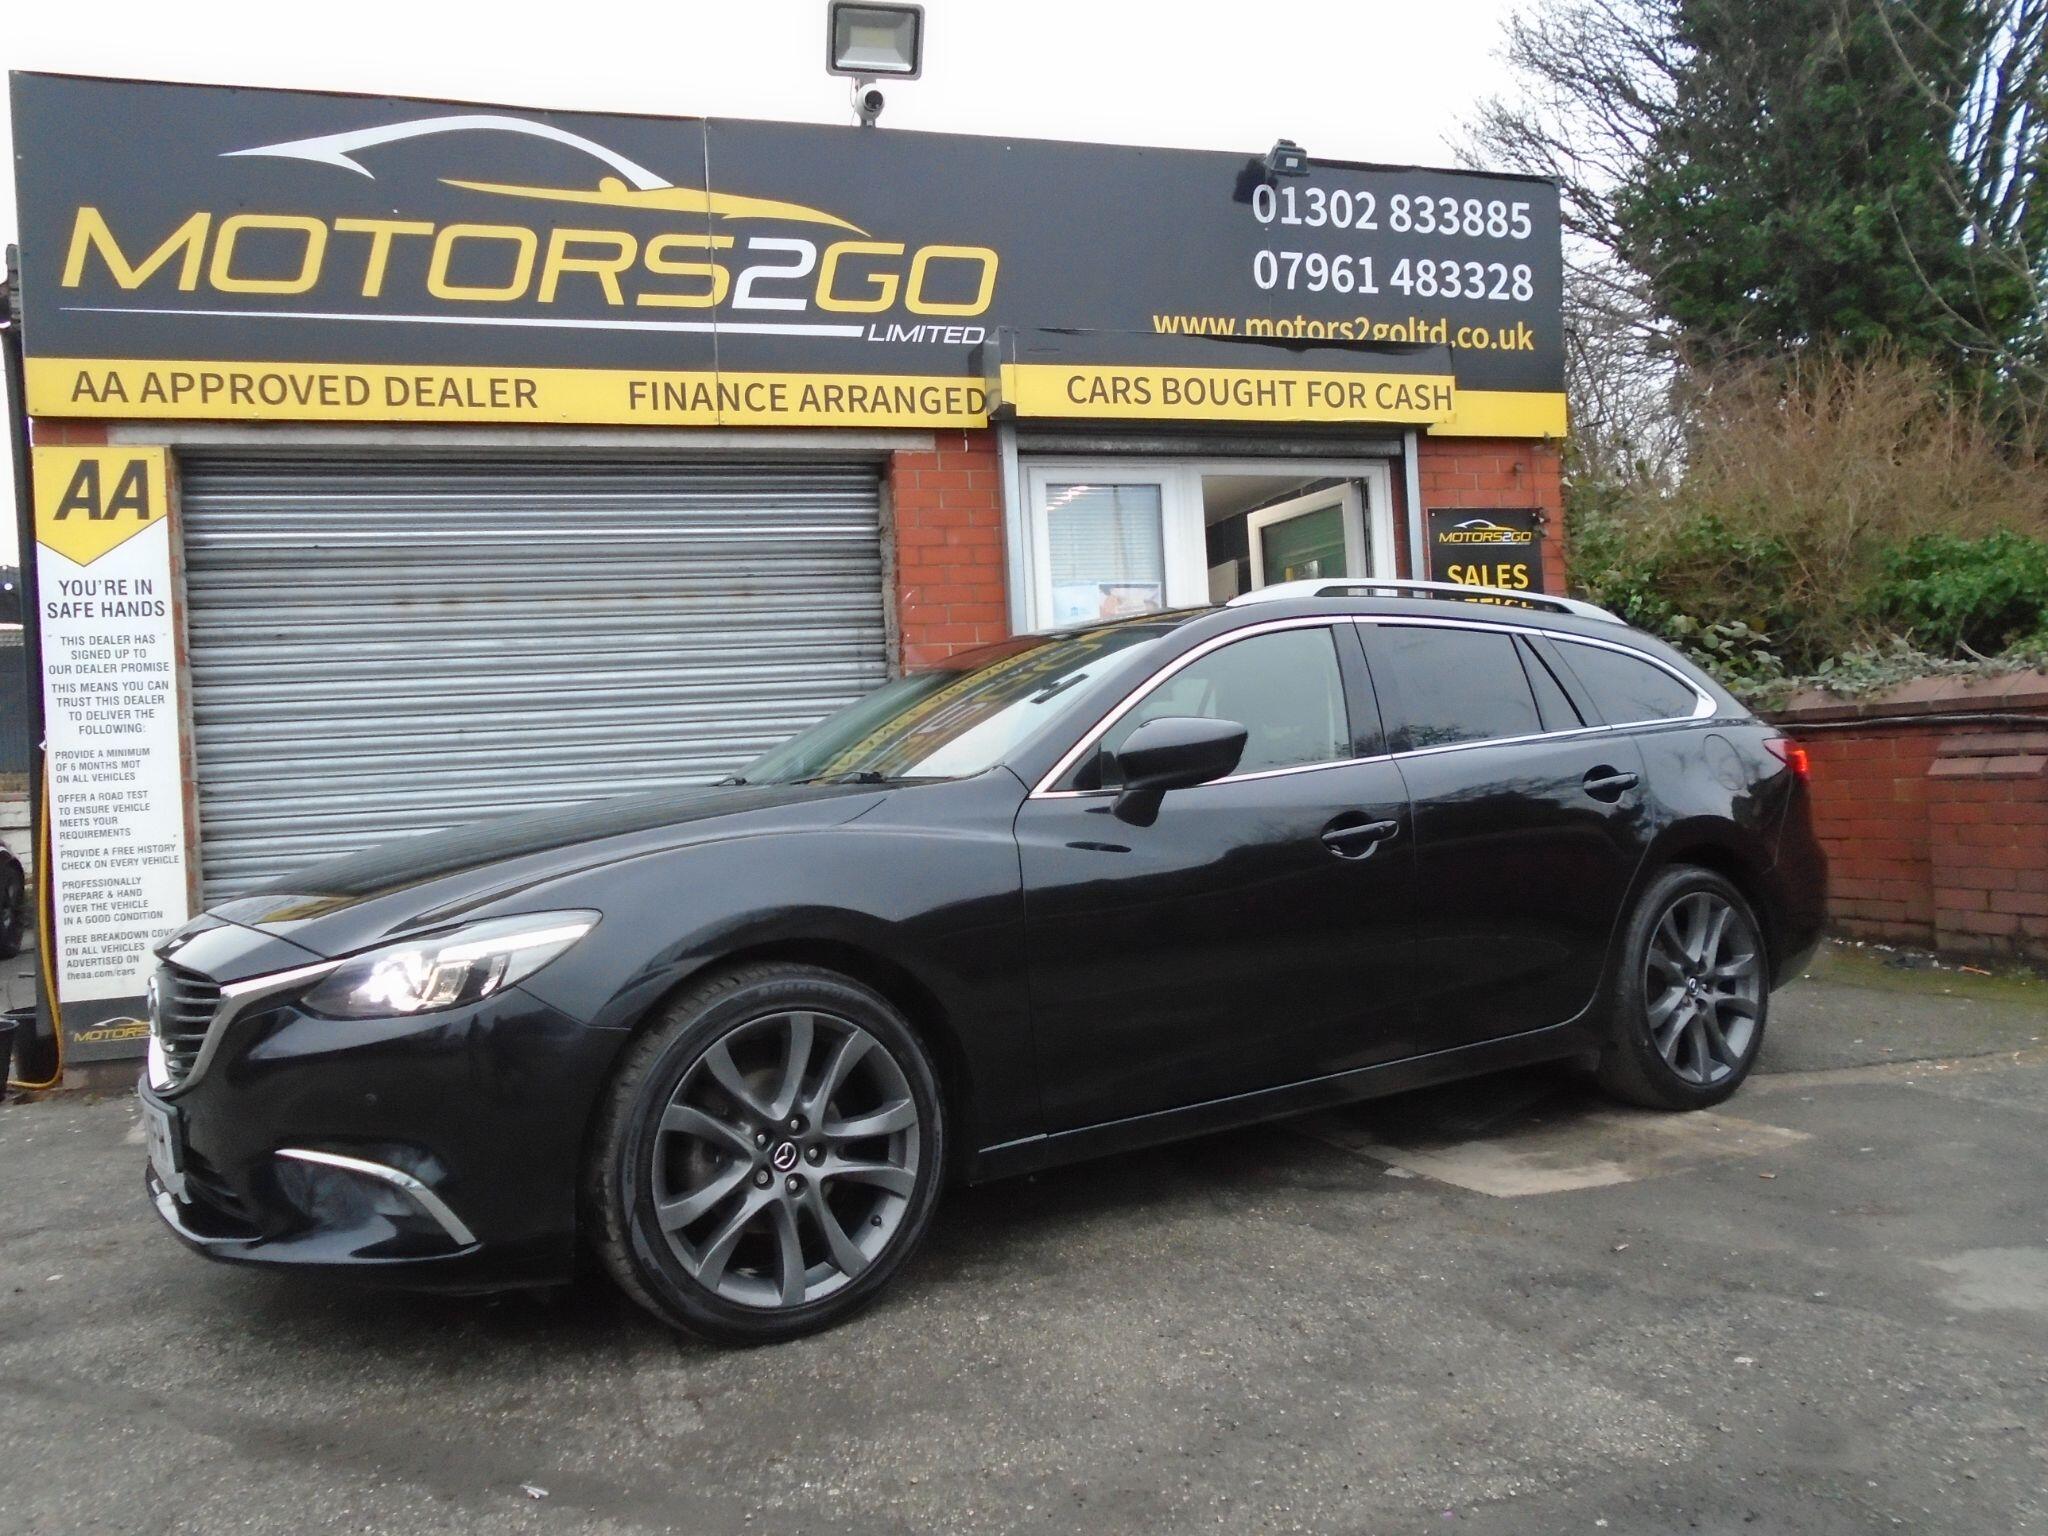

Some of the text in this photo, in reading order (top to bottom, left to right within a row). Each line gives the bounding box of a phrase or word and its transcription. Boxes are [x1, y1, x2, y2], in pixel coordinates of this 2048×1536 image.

[1252, 184, 1532, 239] 01302 833885
[61, 206, 999, 317] MOTORS2GO
[1253, 250, 1534, 302] 07961 483328
[868, 324, 986, 345] LIMITED
[72, 370, 538, 408] AA APPROVED DEALER
[1067, 375, 1453, 411] CARS BOUGHT FOR CASH
[629, 380, 987, 415] FINANCE ARRANGED
[53, 459, 150, 520] AA
[1439, 531, 1532, 543] MOTORS2GO
[1447, 563, 1529, 589] SALES
[58, 579, 153, 596] YOU'RE IN
[47, 600, 165, 618] SAFE HANDS
[60, 634, 156, 646] THIS DEALER HAS
[71, 648, 147, 660] SIGNED UP TO
[48, 662, 169, 675] OUR DEALER PROMISE
[51, 680, 169, 693] THIS MEANS YOU CAN
[56, 695, 165, 707] TRUST THIS DEALER
[68, 708, 155, 721] TO DELIVER THE
[78, 723, 146, 735] FOLLOWING:
[55, 748, 150, 759] PROVIDE A MINIMUM
[55, 763, 67, 772] OF
[78, 761, 118, 771] MONTHS
[56, 772, 136, 784] ON ALL VEHICLES
[57, 790, 148, 803] OFFER A ROAD TEST
[59, 803, 150, 816] TO ENSURE VEHICLE
[60, 817, 118, 828] MEETS YOUR
[59, 828, 132, 840] REQUIREMENTS
[60, 844, 176, 859] PROVIDE A FREE HISTORY
[61, 855, 180, 871] CHECK ON EVERY VEHICLE
[62, 877, 142, 890] PROFESSIONALLY
[62, 889, 143, 901] PREPARE & HAND
[63, 900, 149, 914] OVER THE VEHICLE
[63, 911, 163, 926] IN A GOOD CONDITION
[65, 935, 88, 944] FREE
[90, 930, 149, 942] BREAKDOWN
[65, 943, 145, 956] ON ALL VEHICLES
[66, 954, 140, 968] ADVERTISED ON
